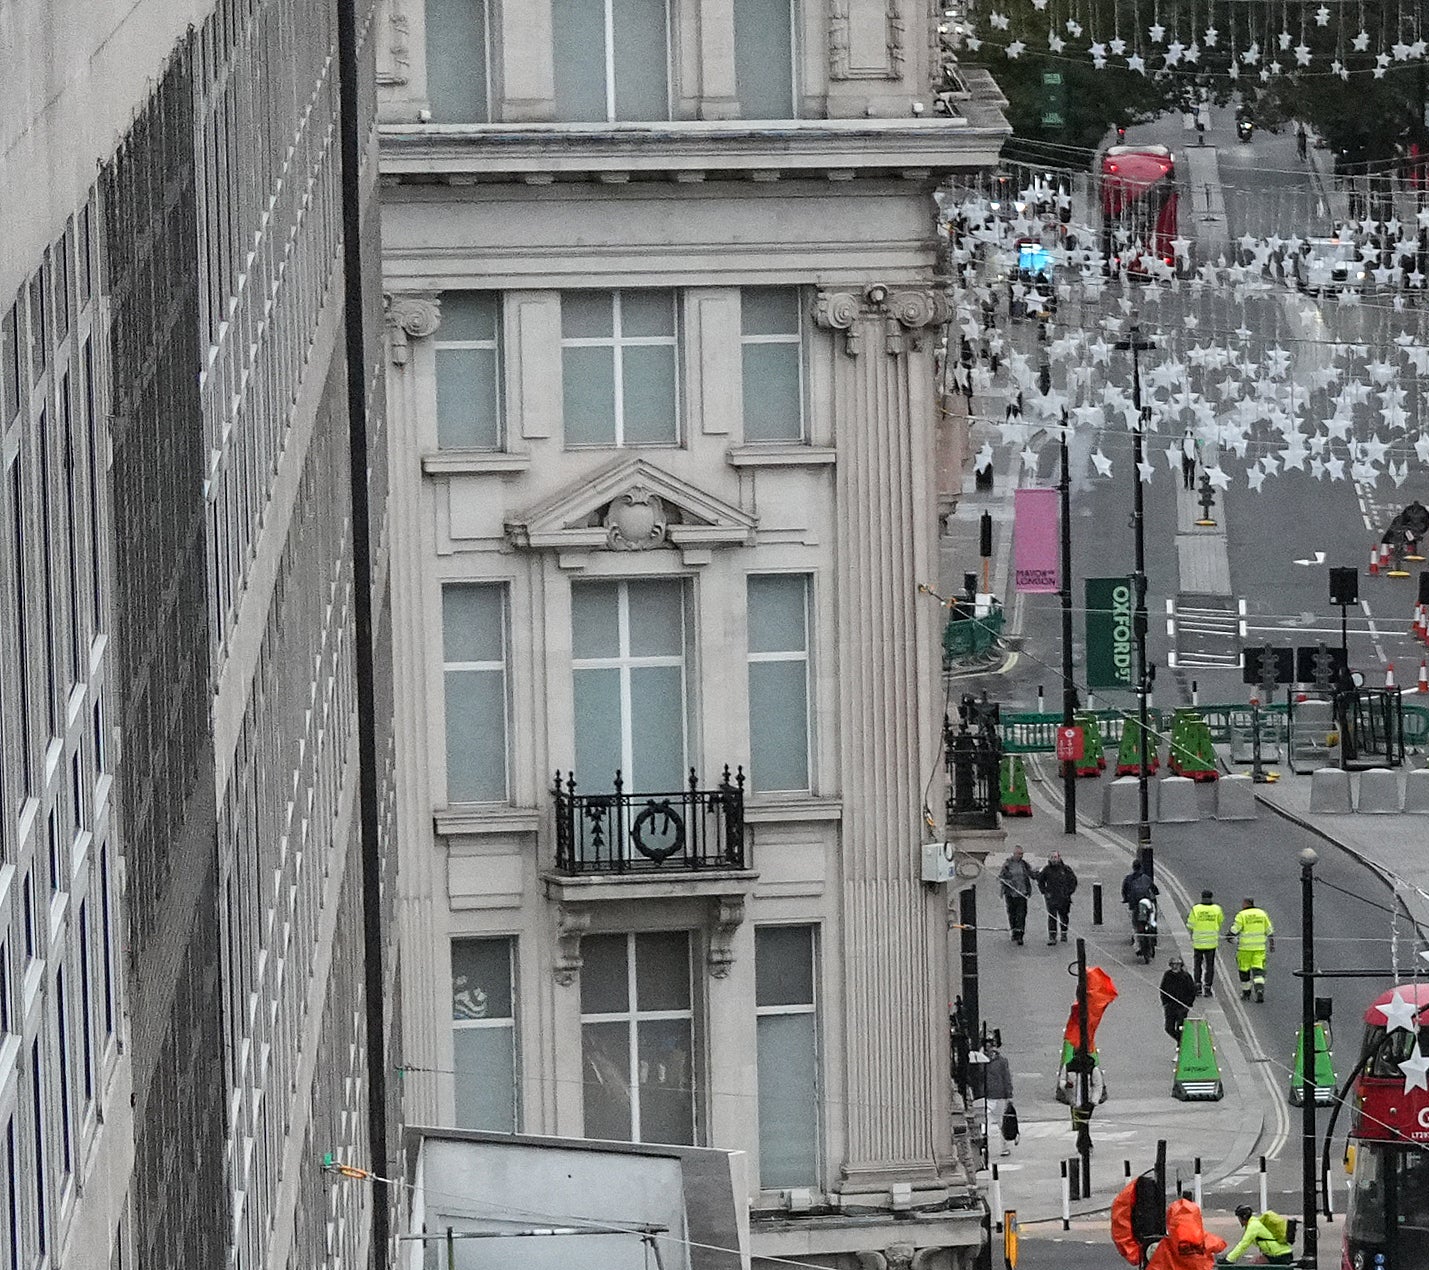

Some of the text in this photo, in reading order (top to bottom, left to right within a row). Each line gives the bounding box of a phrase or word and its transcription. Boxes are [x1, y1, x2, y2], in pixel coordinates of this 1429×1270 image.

[1016, 577, 1056, 586] LONDON
[1112, 586, 1131, 682] OXFORD ST
